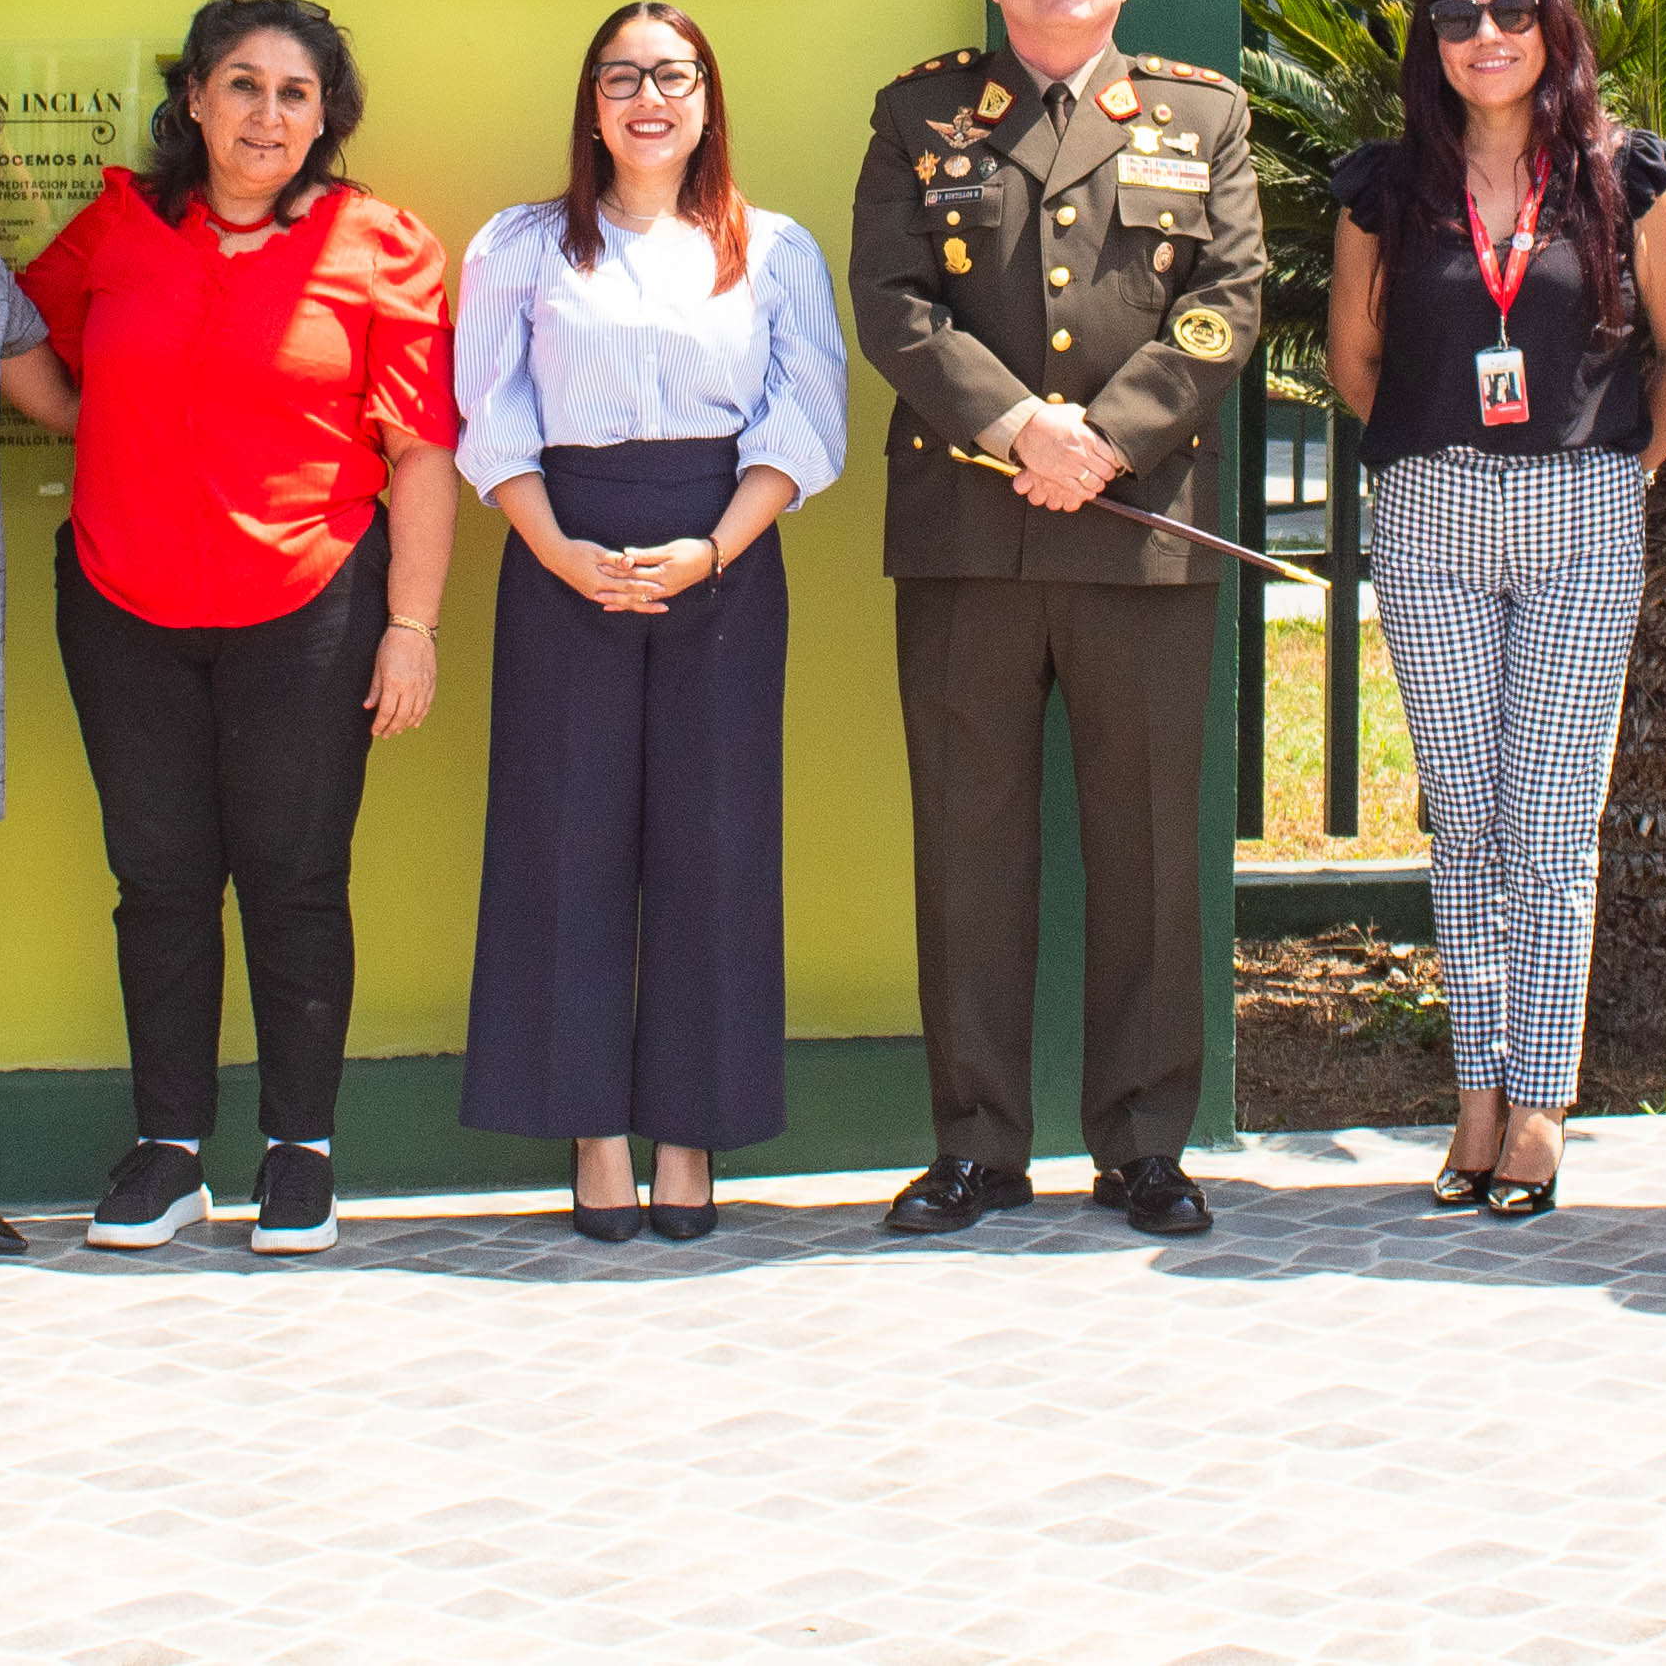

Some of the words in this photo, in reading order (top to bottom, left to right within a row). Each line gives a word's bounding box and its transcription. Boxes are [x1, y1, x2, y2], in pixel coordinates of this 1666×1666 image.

[22, 88, 122, 112] INCLÁN
[83, 154, 104, 166] AL
[72, 180, 89, 190] DE
